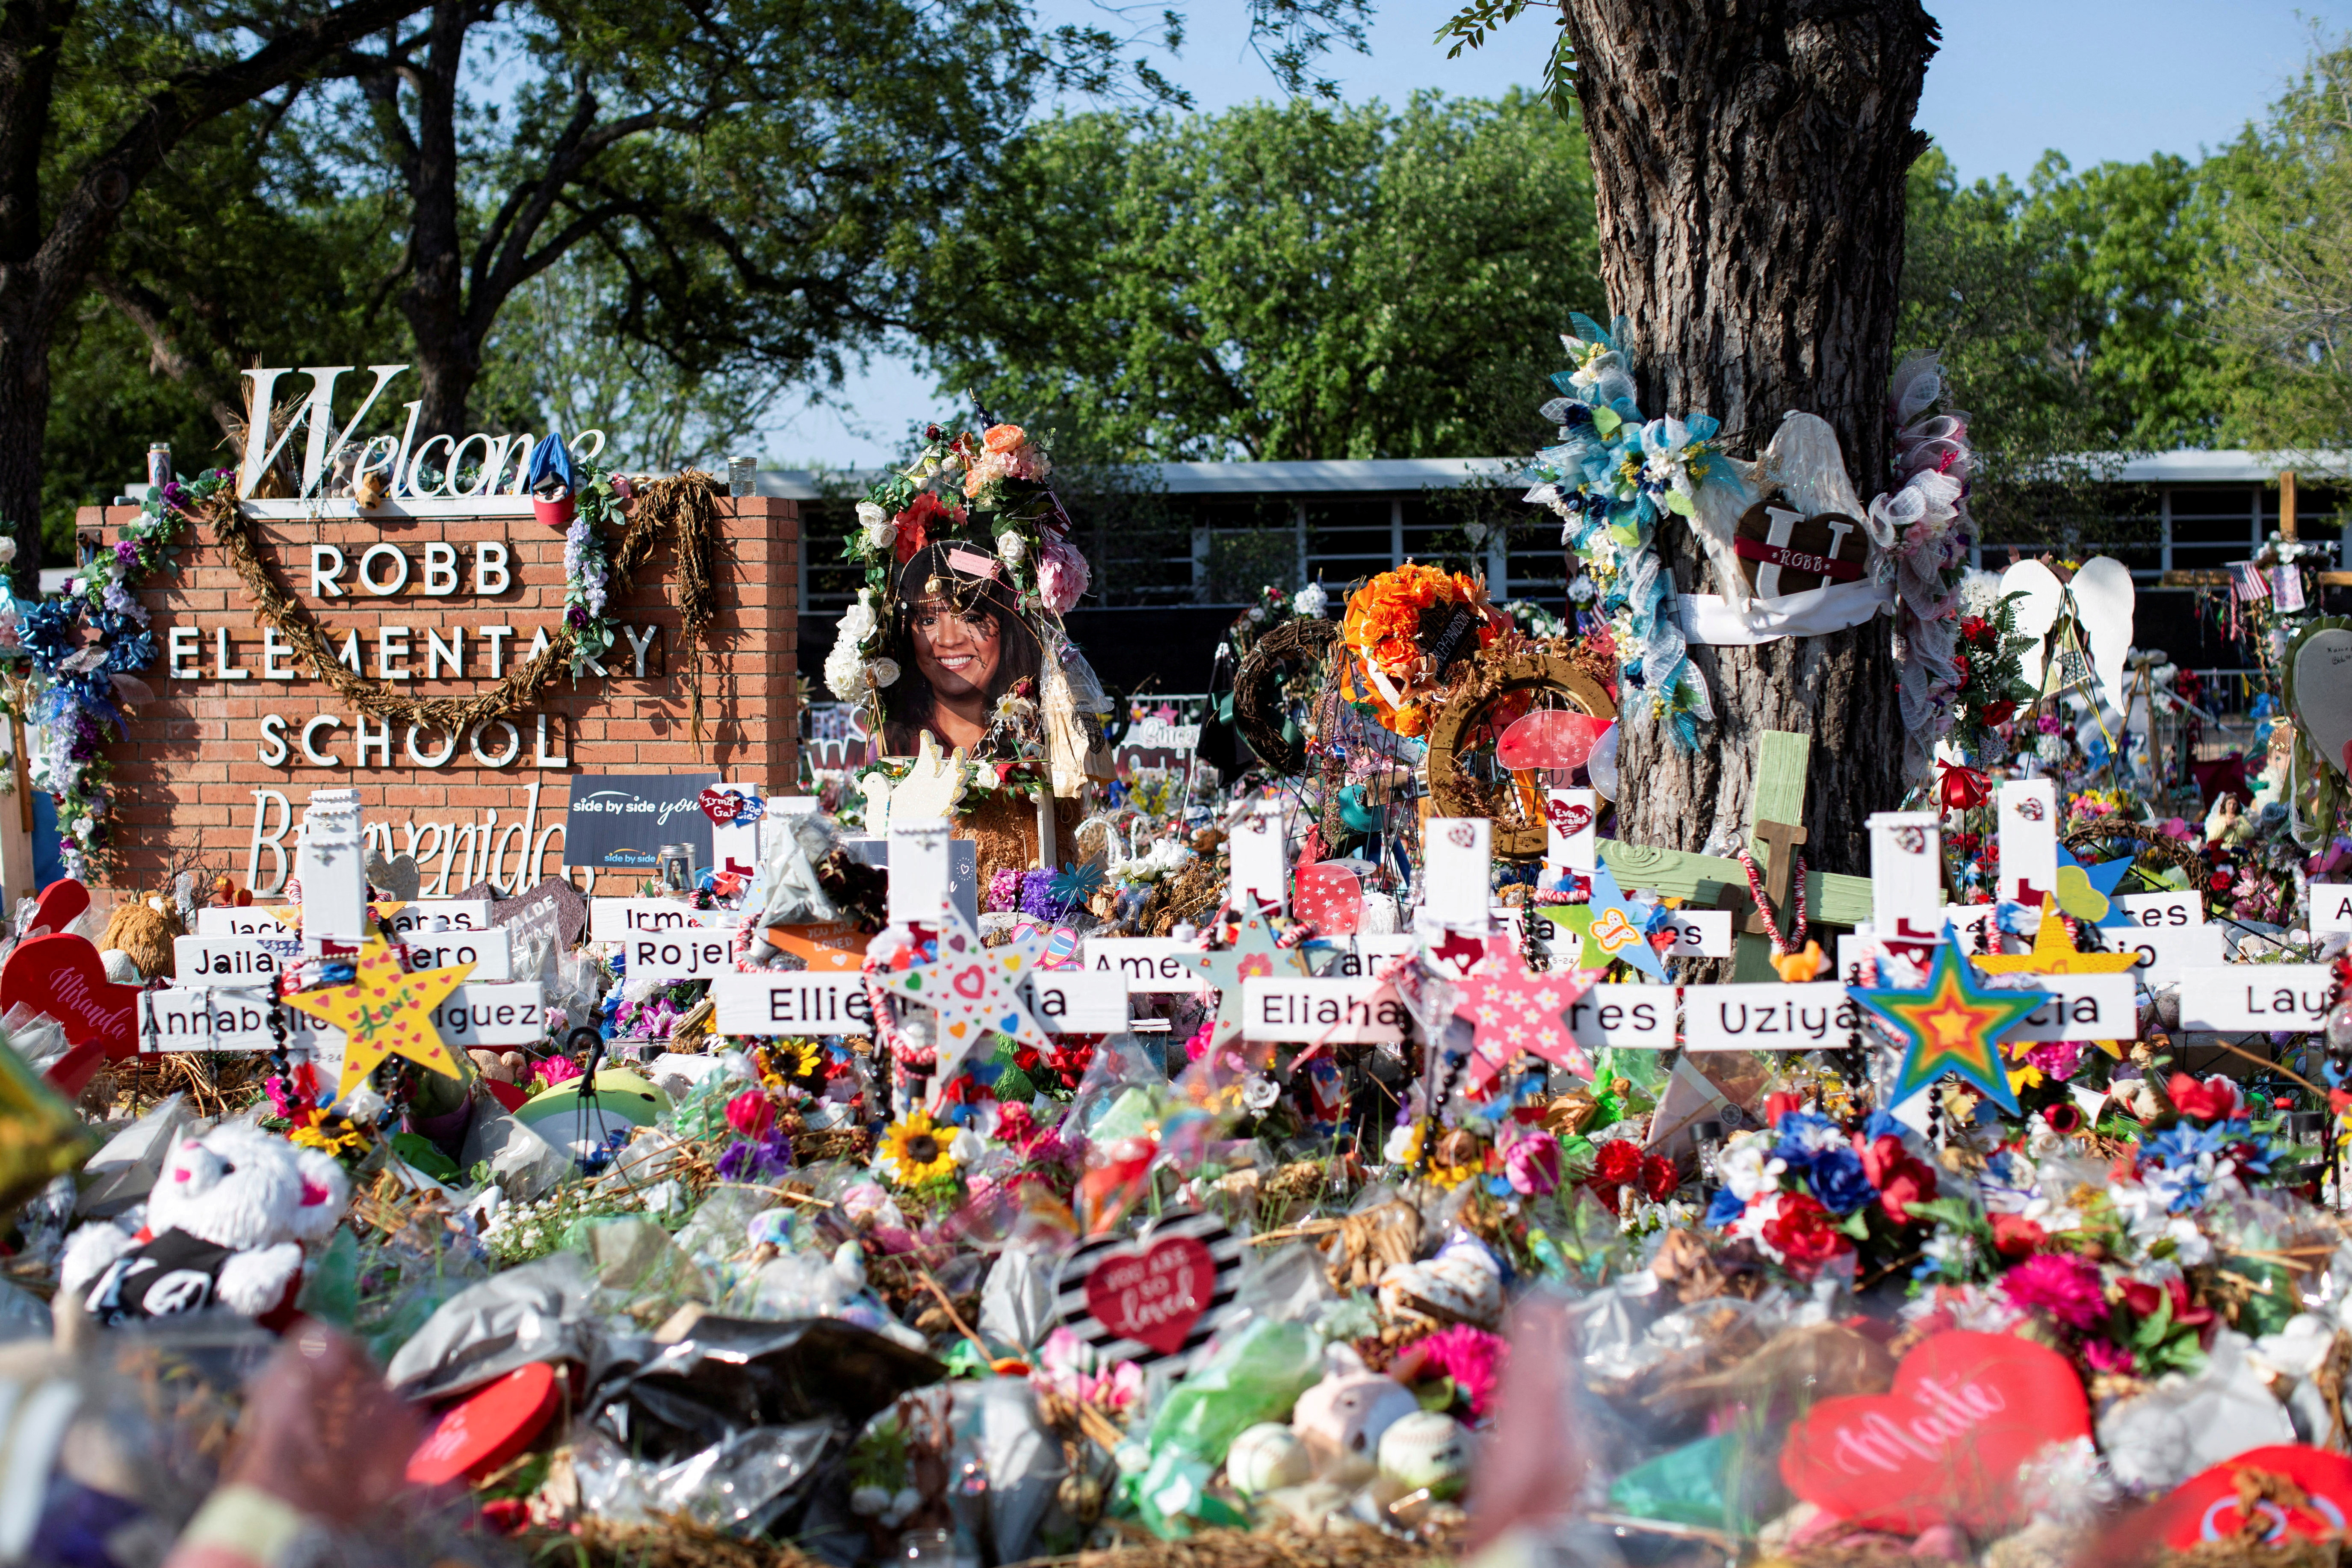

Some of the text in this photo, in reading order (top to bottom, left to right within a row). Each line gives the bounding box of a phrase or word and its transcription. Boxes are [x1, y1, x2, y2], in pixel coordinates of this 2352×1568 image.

[311, 541, 511, 596] ROBB
[1431, 608, 1471, 677] RLEY-DAVIDSON
[259, 714, 569, 768] SCHOOL
[573, 797, 603, 812] side
[606, 800, 623, 815] by
[626, 795, 656, 813] side
[604, 853, 623, 863] side
[625, 853, 636, 865] by
[638, 852, 656, 863] side
[807, 927, 829, 939] YOU
[813, 937, 854, 952] LOVED
[50, 966, 133, 1040] Miranda
[770, 987, 866, 1022] Ellie
[1107, 1245, 1188, 1291] YOU ARE
[1115, 1266, 1200, 1332] loved
[1139, 1277, 1170, 1300] SO
